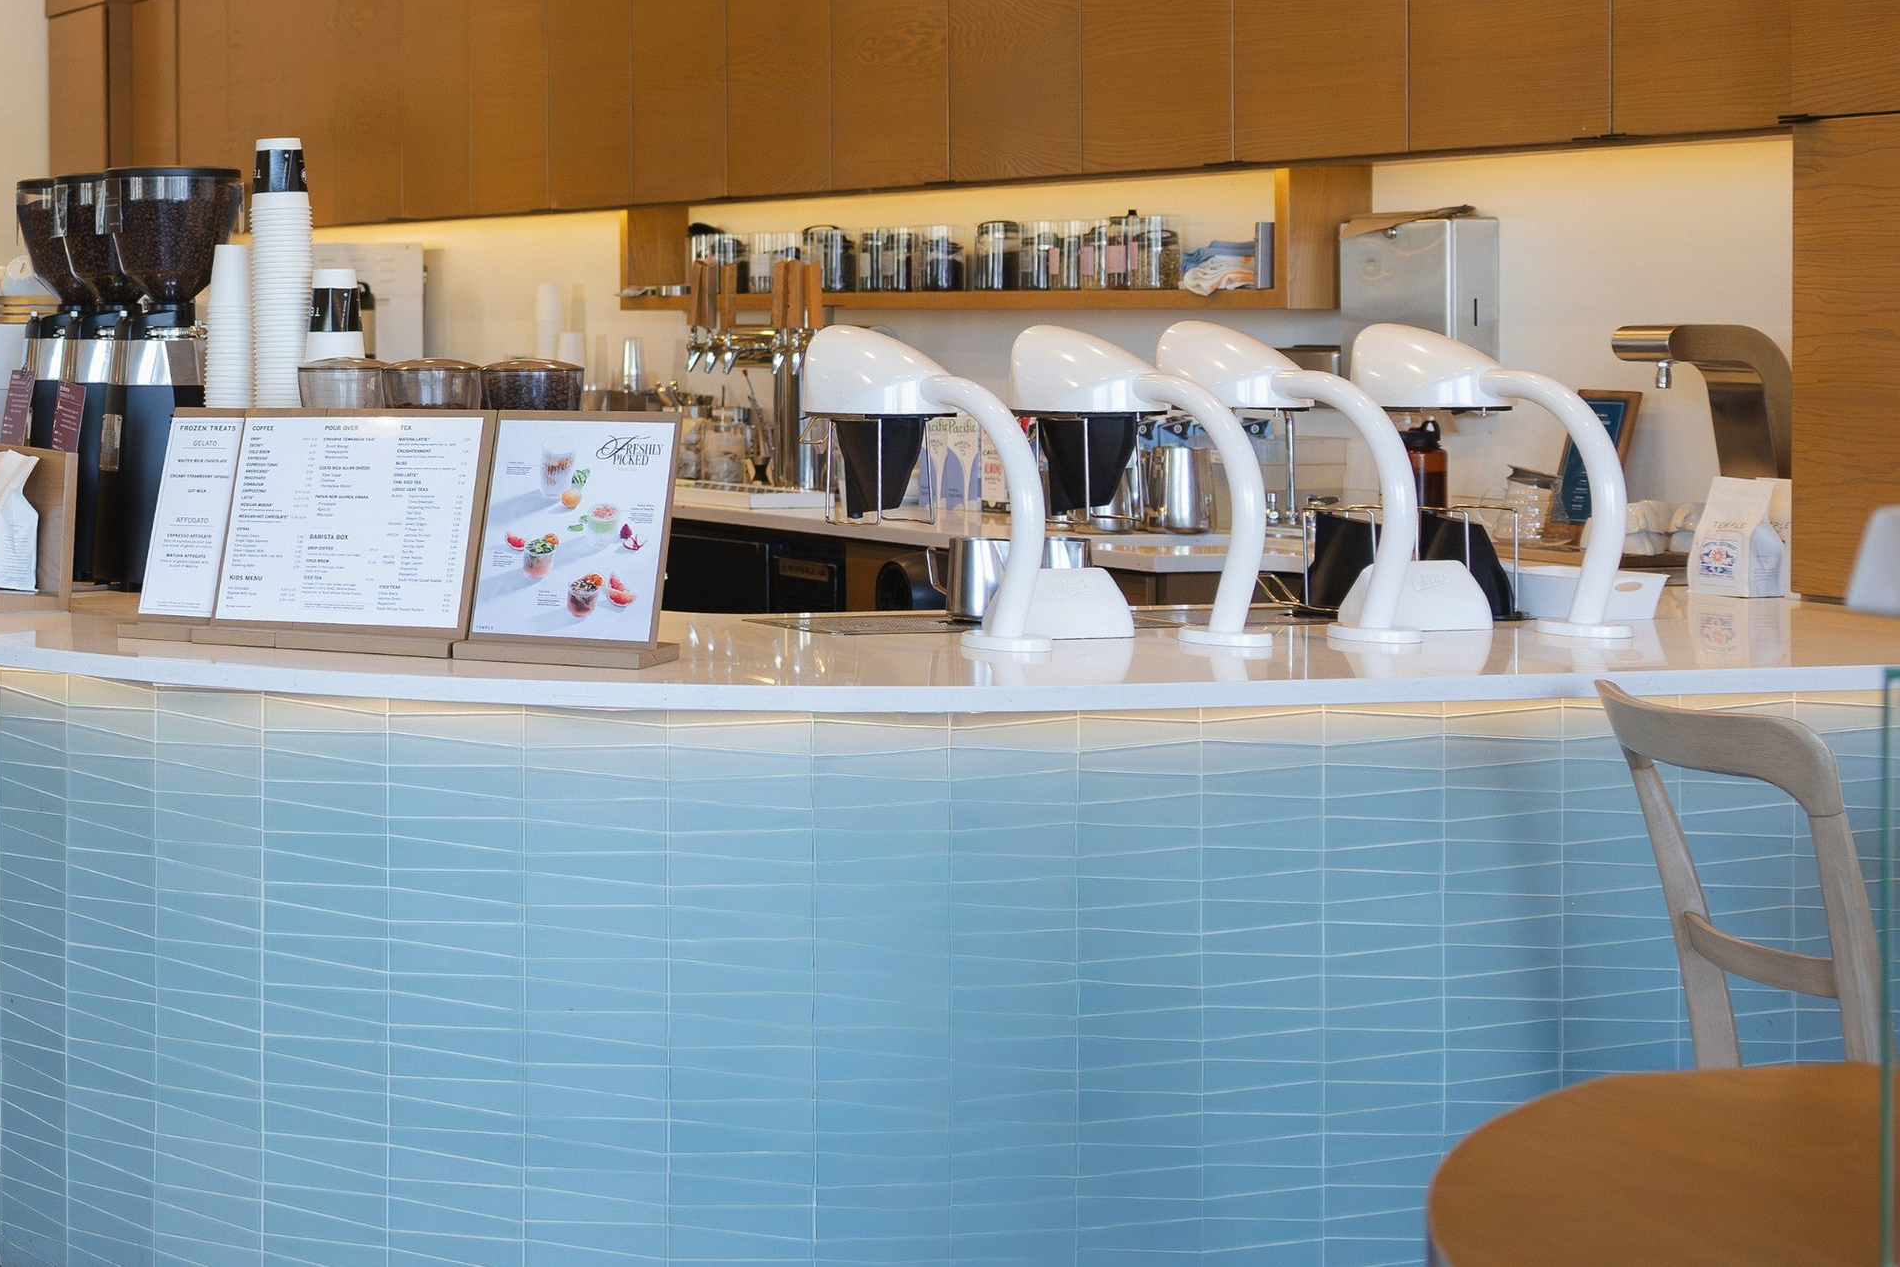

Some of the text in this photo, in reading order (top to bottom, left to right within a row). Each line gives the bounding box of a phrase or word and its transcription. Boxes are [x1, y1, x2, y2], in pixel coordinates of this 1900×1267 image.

[948, 419, 977, 433] Pacific
[596, 435, 663, 459] FRESHLY
[613, 455, 649, 466] PICKED
[1712, 521, 1747, 529] TEMPLE
